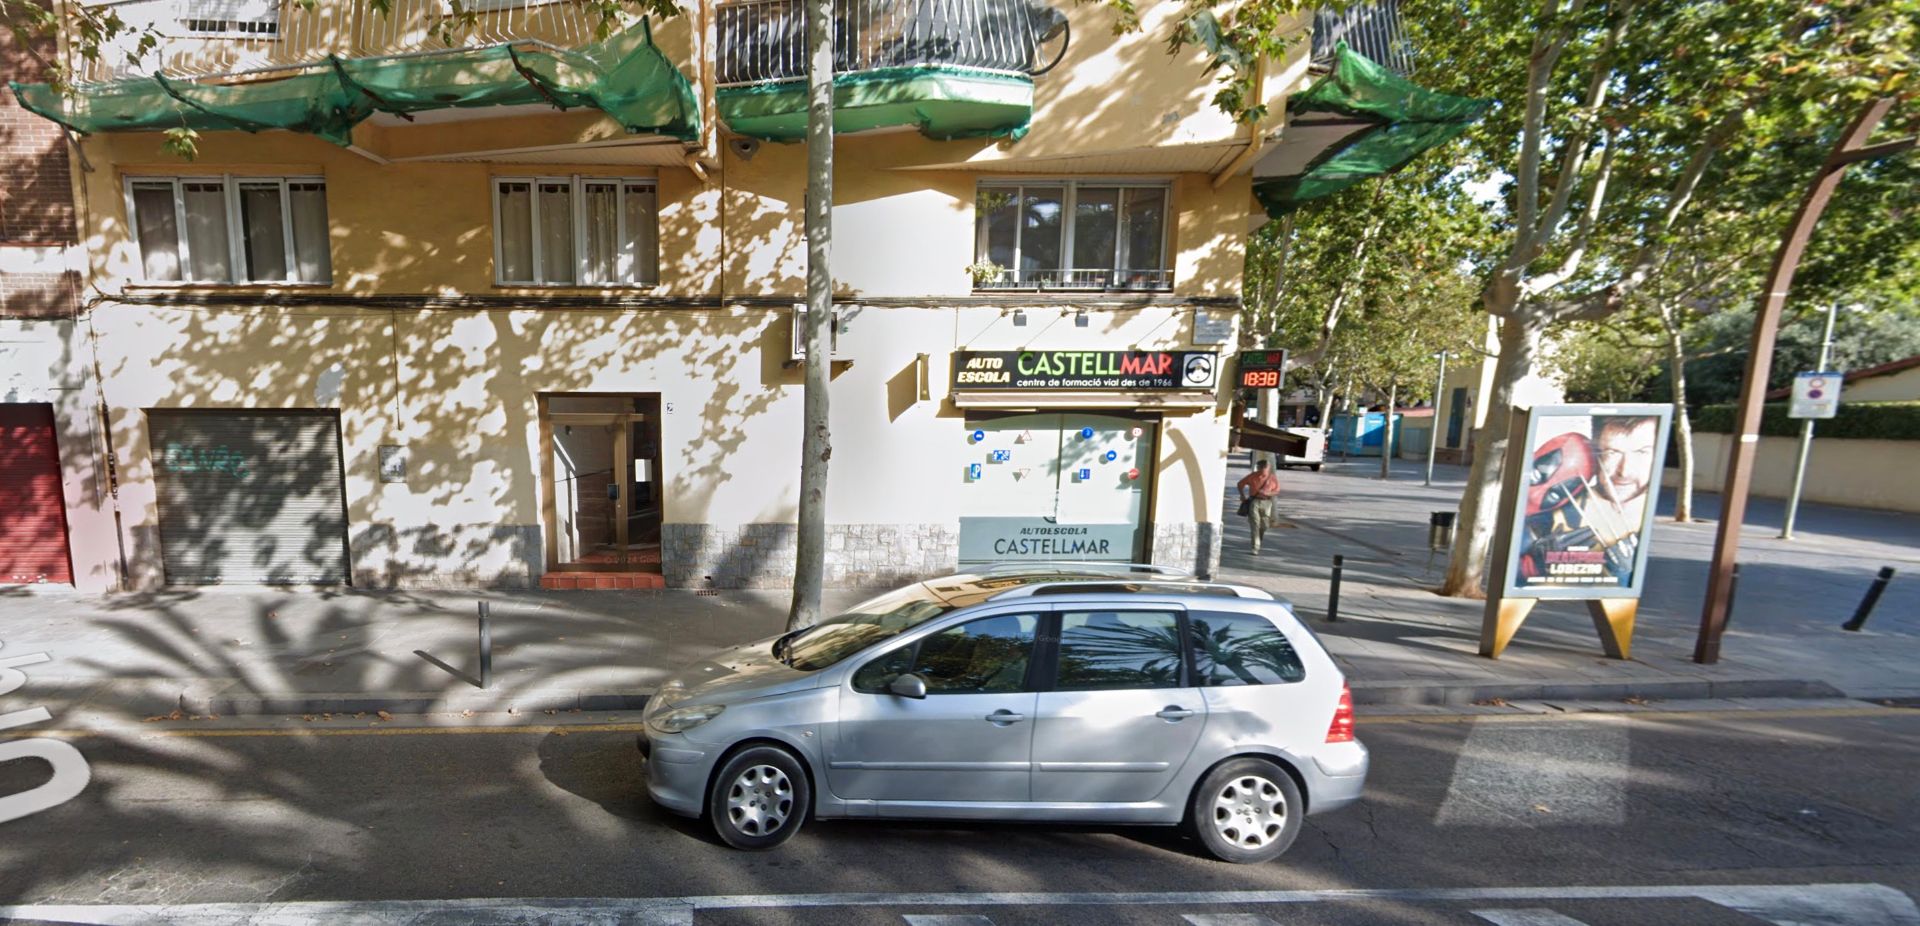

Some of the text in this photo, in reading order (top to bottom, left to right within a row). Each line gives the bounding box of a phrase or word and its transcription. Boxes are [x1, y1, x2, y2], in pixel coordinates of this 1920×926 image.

[966, 357, 1004, 369] AUTO
[1017, 352, 1173, 376] CASTELLMAR
[957, 371, 1011, 383] ESCOLA
[1016, 377, 1173, 387] centre de formació vial des de 1966
[1243, 371, 1278, 387] 18:38
[1019, 527, 1088, 535] AUTOESCOLA
[993, 538, 1110, 555] CASTELLMAR
